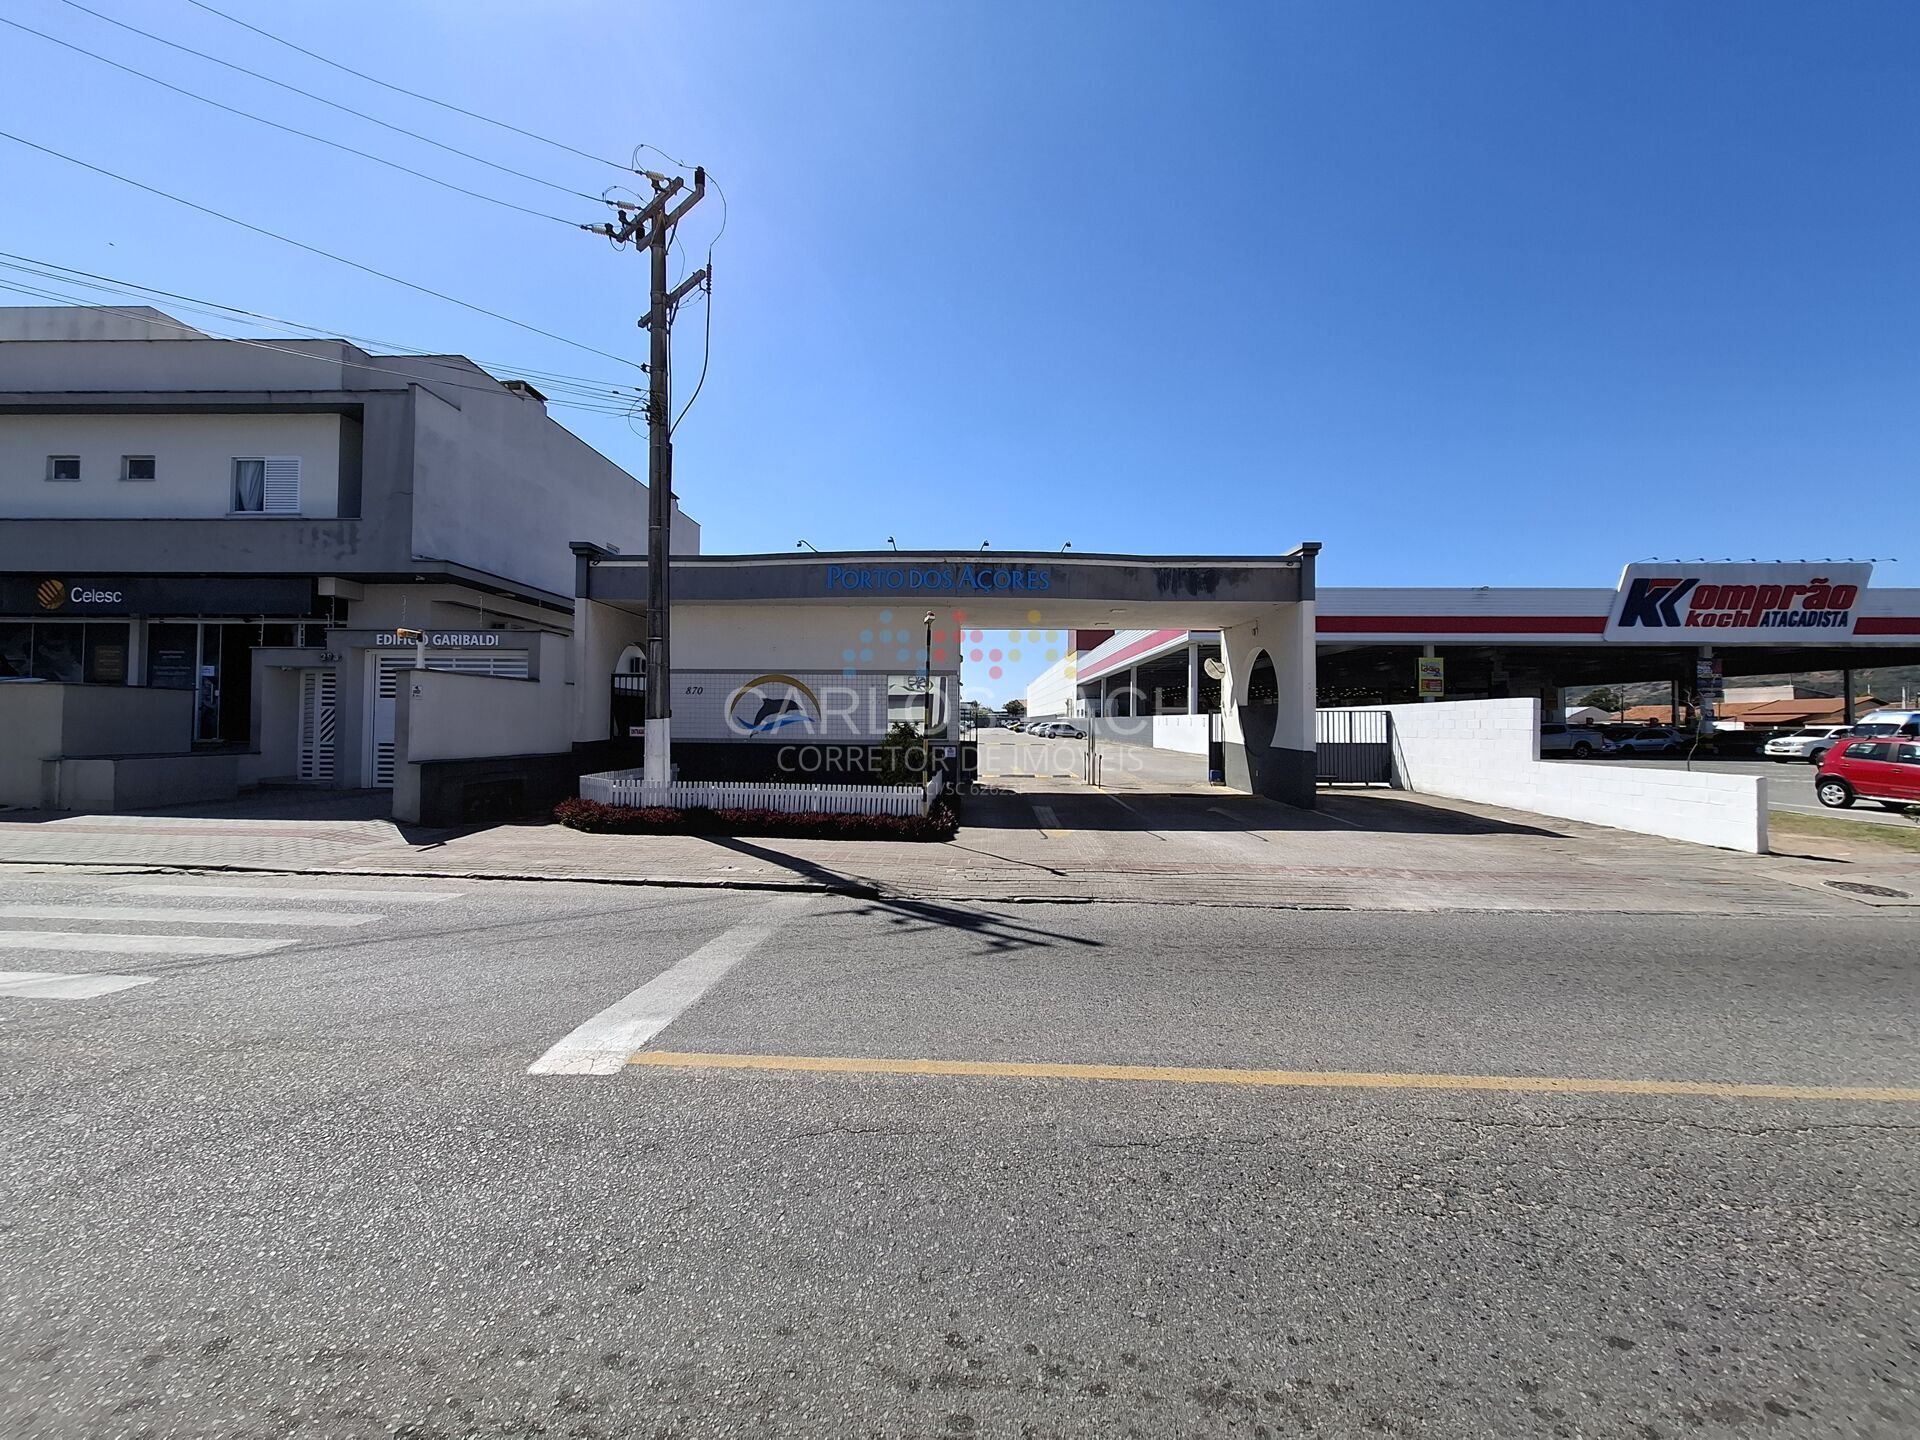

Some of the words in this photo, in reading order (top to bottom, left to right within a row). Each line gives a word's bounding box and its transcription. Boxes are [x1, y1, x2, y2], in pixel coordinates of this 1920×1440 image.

[827, 565, 904, 590] PORTO
[909, 568, 953, 590] DOS
[958, 565, 1049, 593] AÇORES
[71, 587, 122, 603] Celesc
[1759, 610, 1848, 628] ATACADISTA
[376, 633, 429, 646] EDIFICO
[432, 633, 499, 647] GARIBALDI
[685, 686, 704, 695] 870
